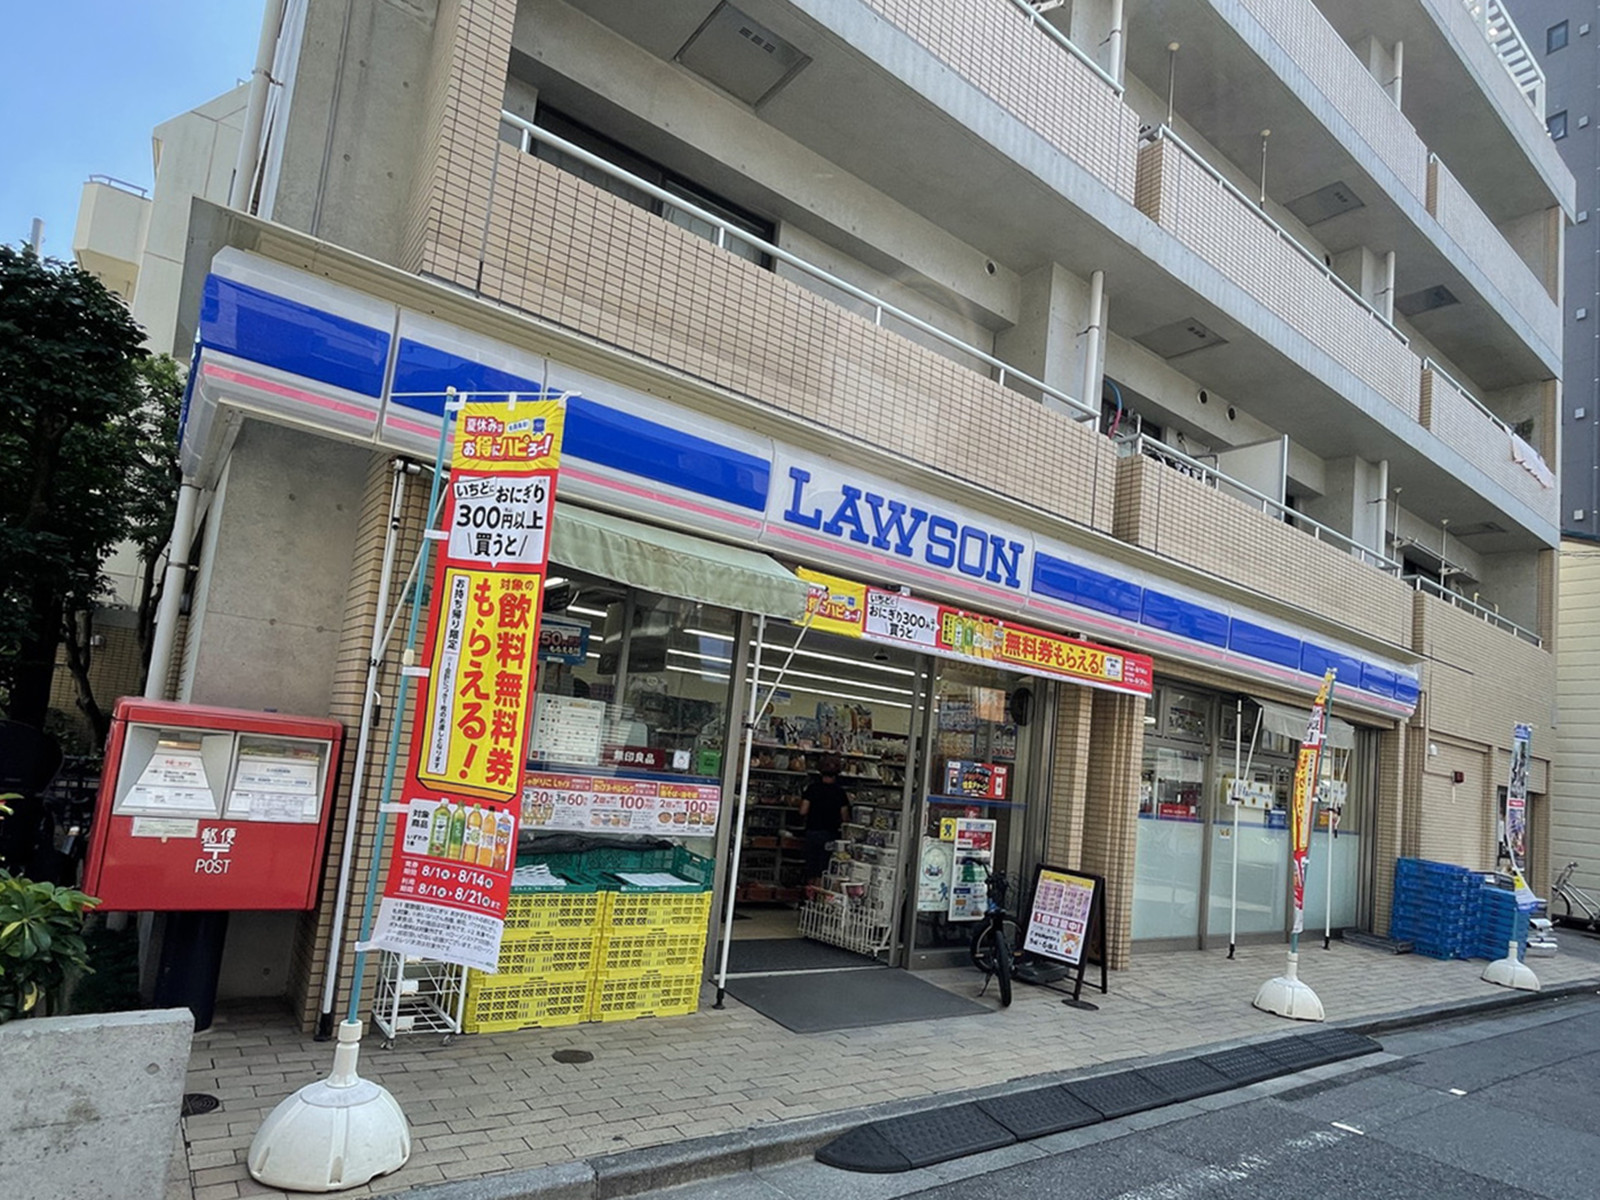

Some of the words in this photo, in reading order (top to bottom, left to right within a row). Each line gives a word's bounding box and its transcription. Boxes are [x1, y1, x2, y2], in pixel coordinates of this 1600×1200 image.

[495, 484, 544, 503] おにぎり
[456, 504, 543, 529] 300円以上
[784, 466, 1024, 588] LAWSON
[474, 533, 517, 556] 買うと
[500, 578, 534, 591] 対象の
[1004, 631, 1105, 675] 無料券もらえる!
[485, 593, 532, 786] 飲料無料券
[613, 749, 656, 765] 無印良品
[619, 796, 644, 810] 100
[684, 801, 708, 813] 100
[201, 827, 237, 845] 郵便
[195, 859, 231, 874] POST
